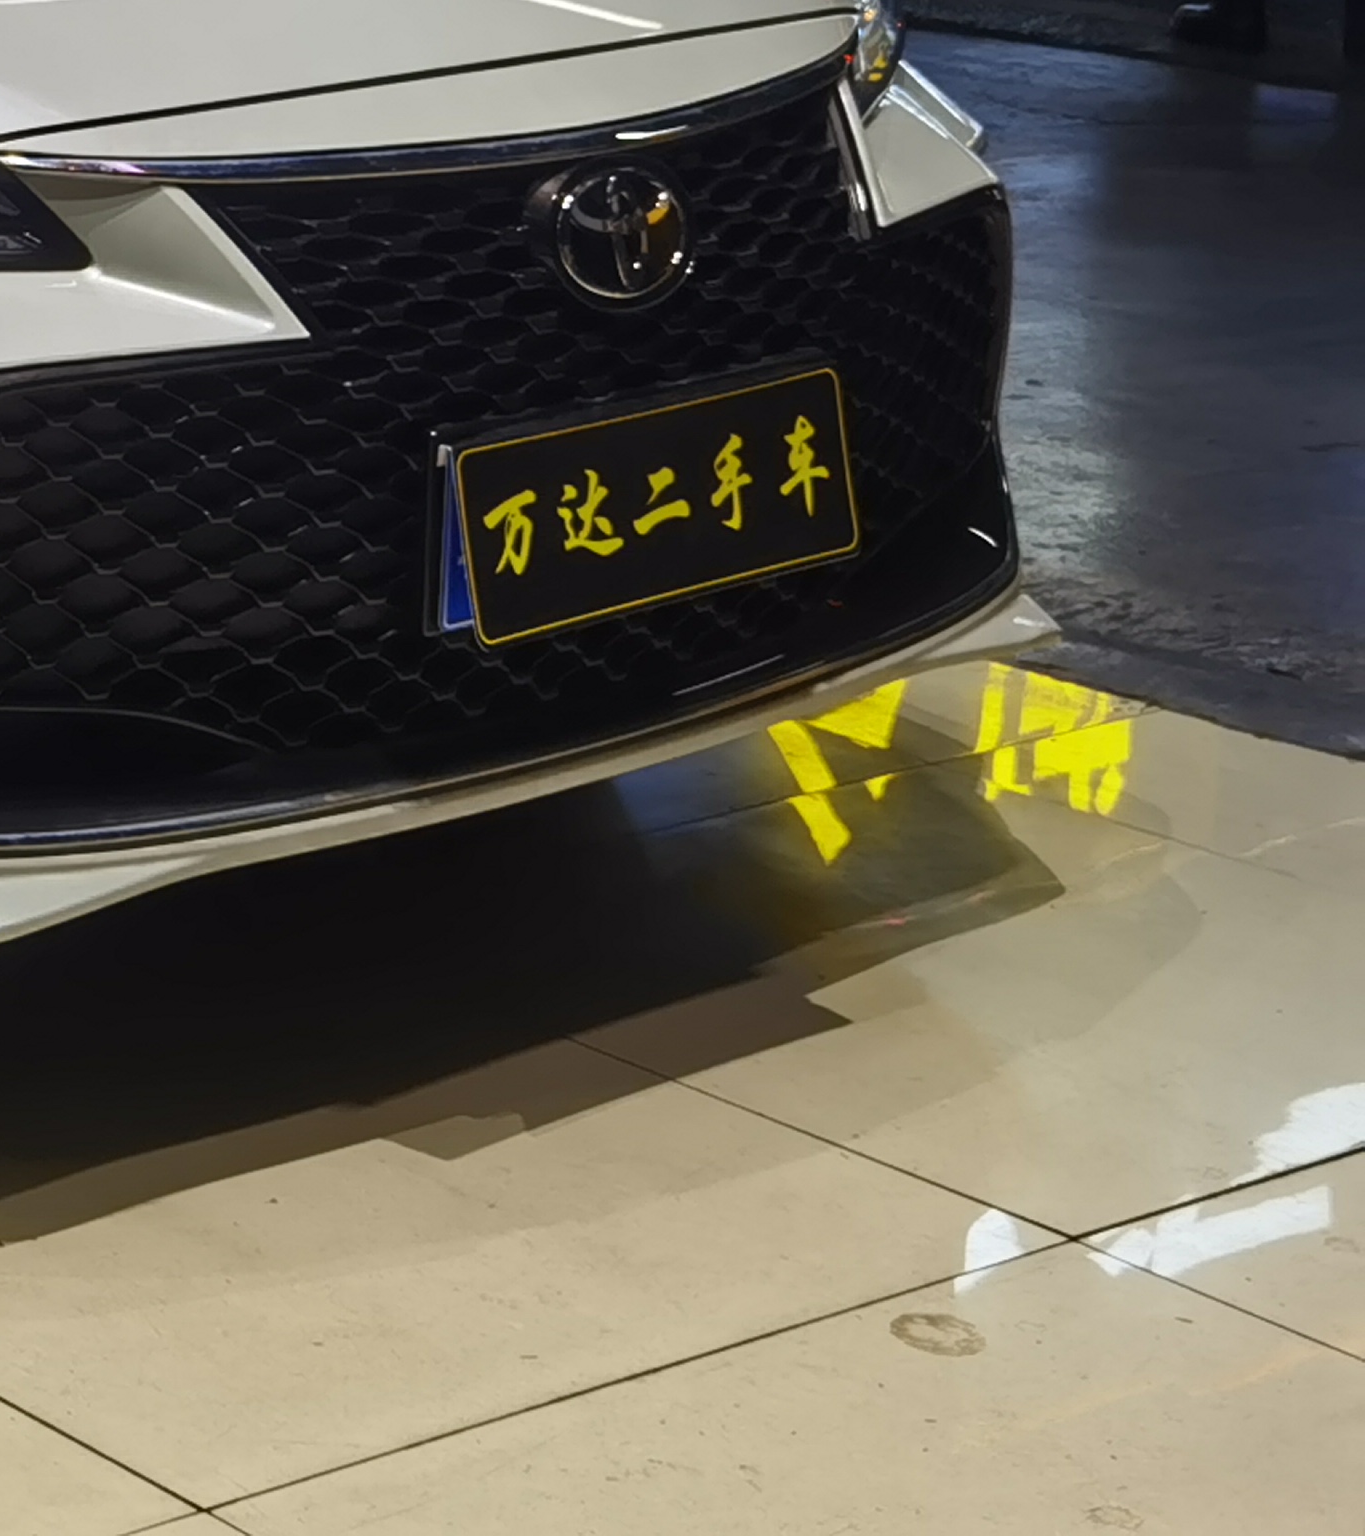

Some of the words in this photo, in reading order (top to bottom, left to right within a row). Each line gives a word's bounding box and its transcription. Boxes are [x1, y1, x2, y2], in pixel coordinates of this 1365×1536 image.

[482, 414, 831, 577] 万达二手车
